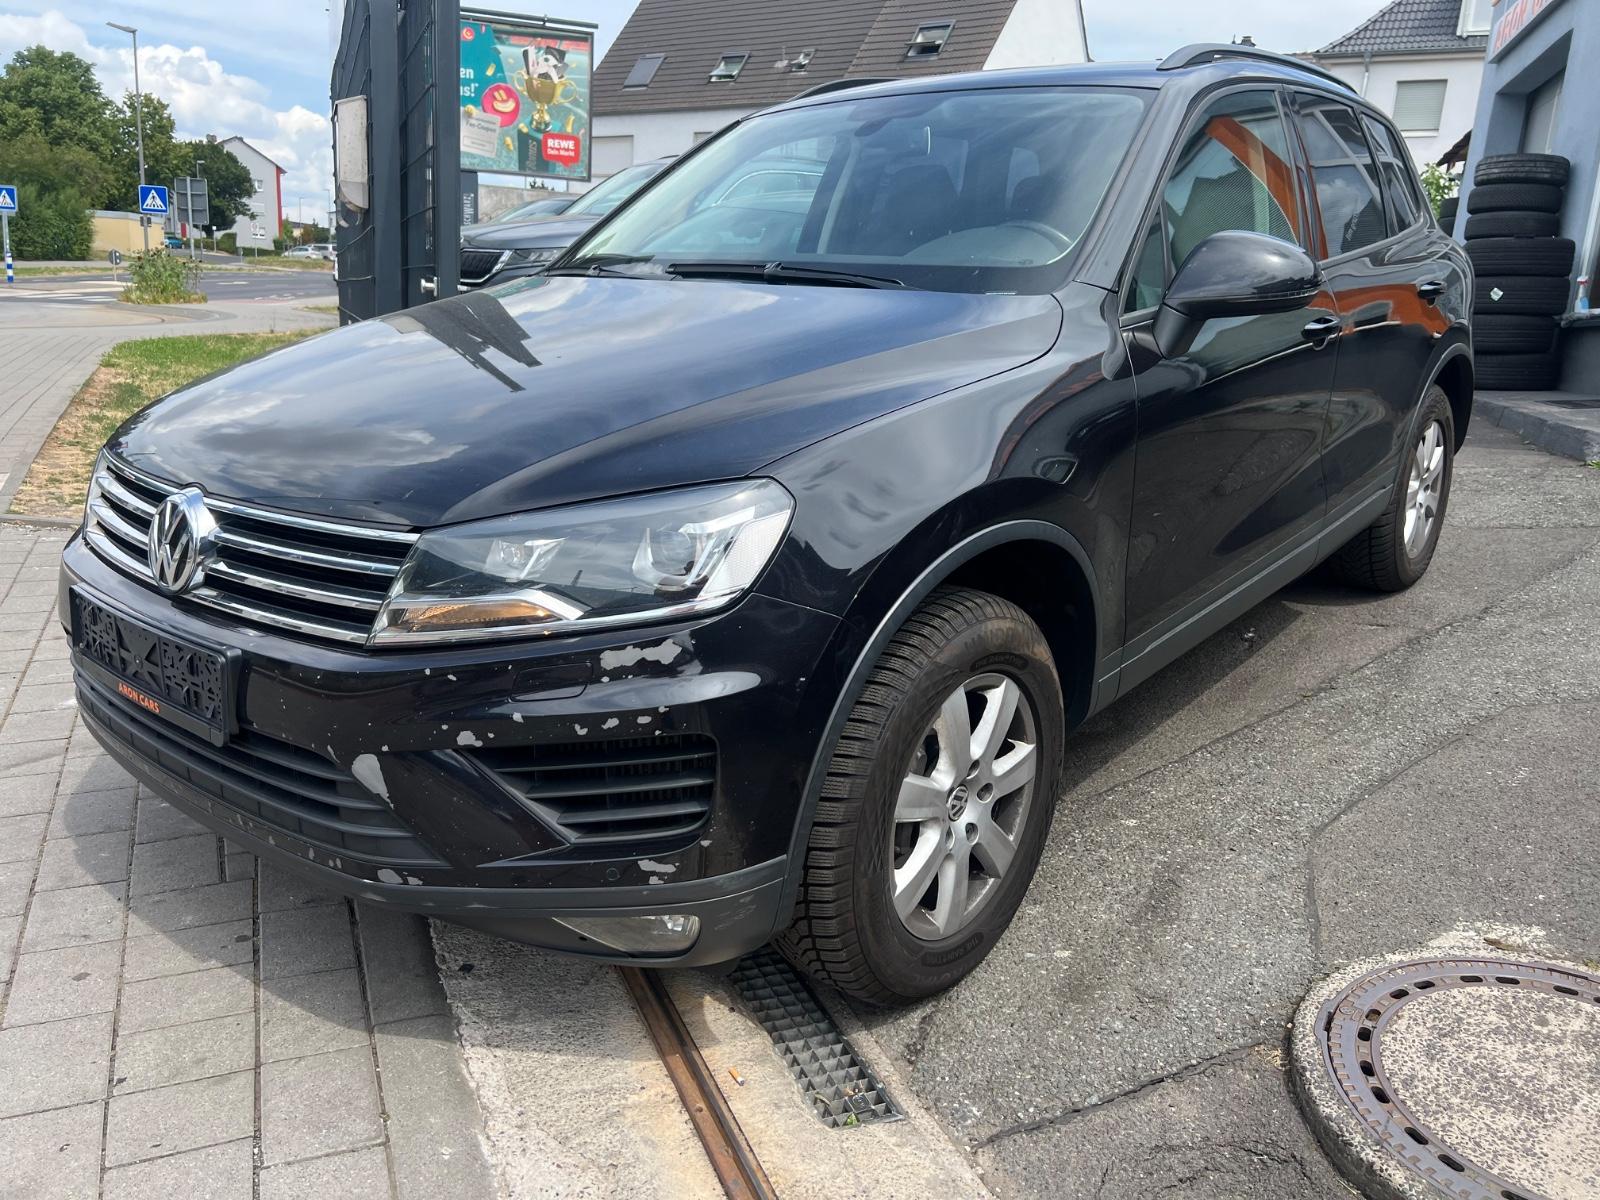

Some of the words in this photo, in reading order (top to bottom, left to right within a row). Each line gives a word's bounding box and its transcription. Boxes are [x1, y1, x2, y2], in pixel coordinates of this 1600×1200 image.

[546, 138, 575, 150] REWE
[118, 682, 139, 702] ARON
[139, 694, 160, 714] CARS
